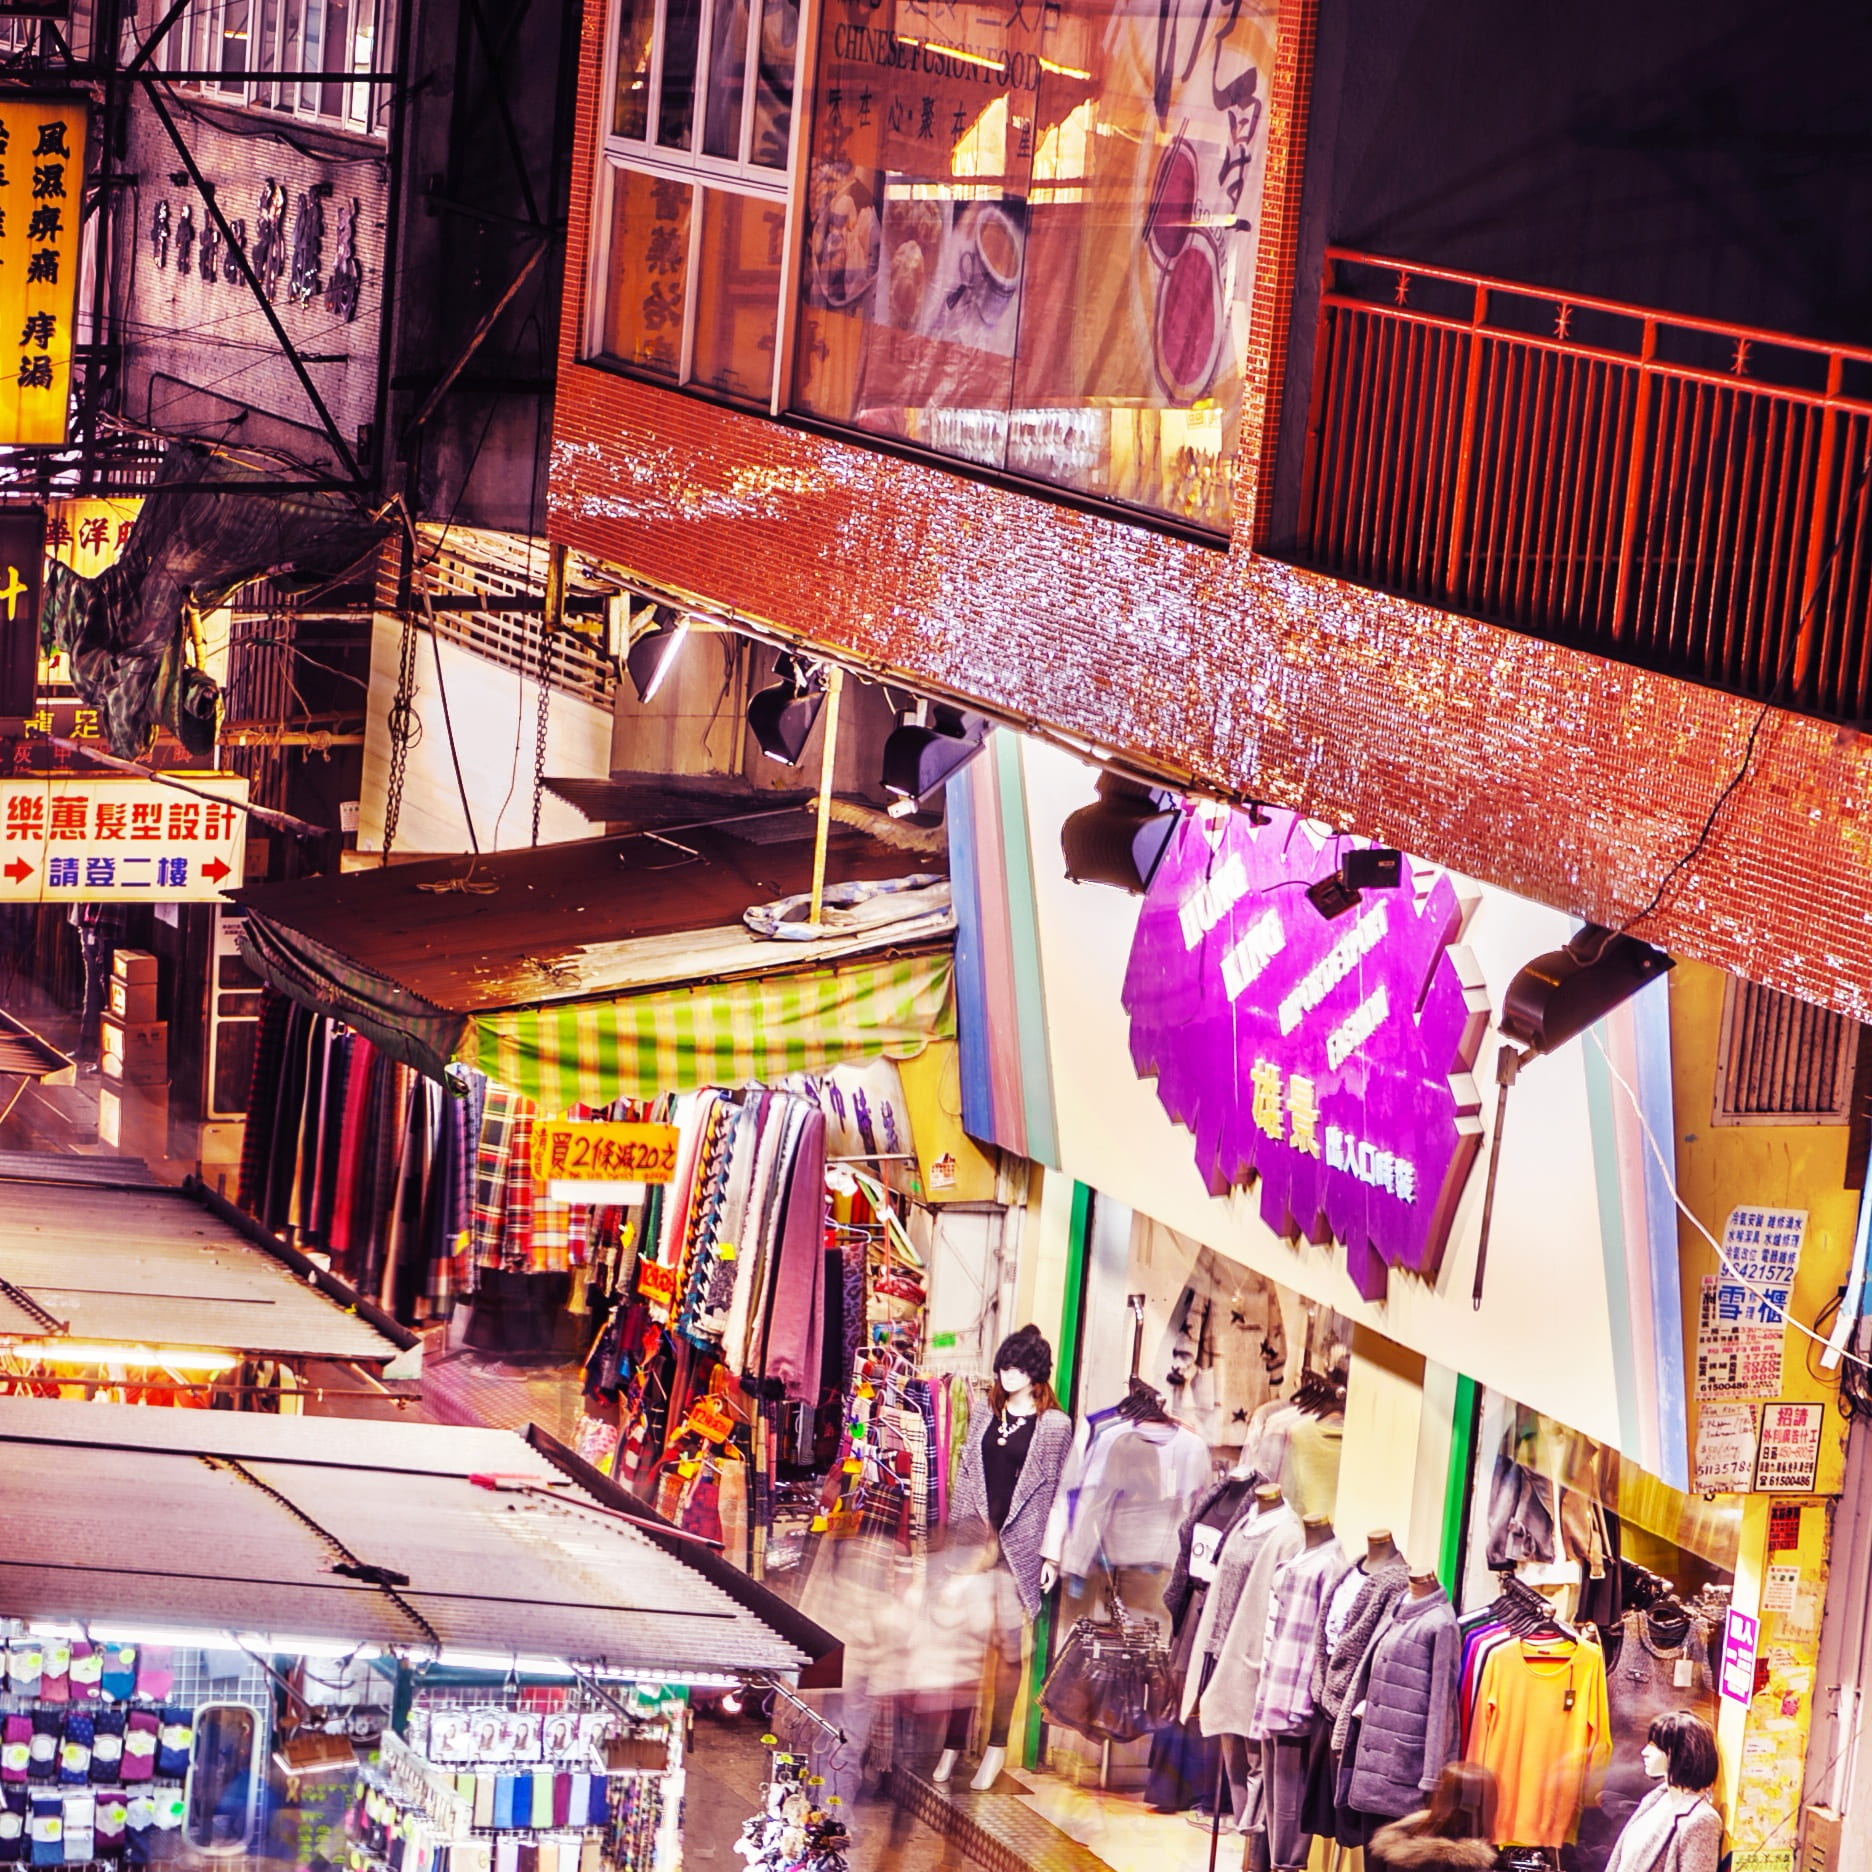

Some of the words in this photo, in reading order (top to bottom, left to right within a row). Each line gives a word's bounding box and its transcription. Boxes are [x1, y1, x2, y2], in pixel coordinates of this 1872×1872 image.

[49, 856, 189, 889] 請登二樓
[1777, 1408, 1809, 1427] 招請
[1769, 1475, 1810, 1487] 61500486
